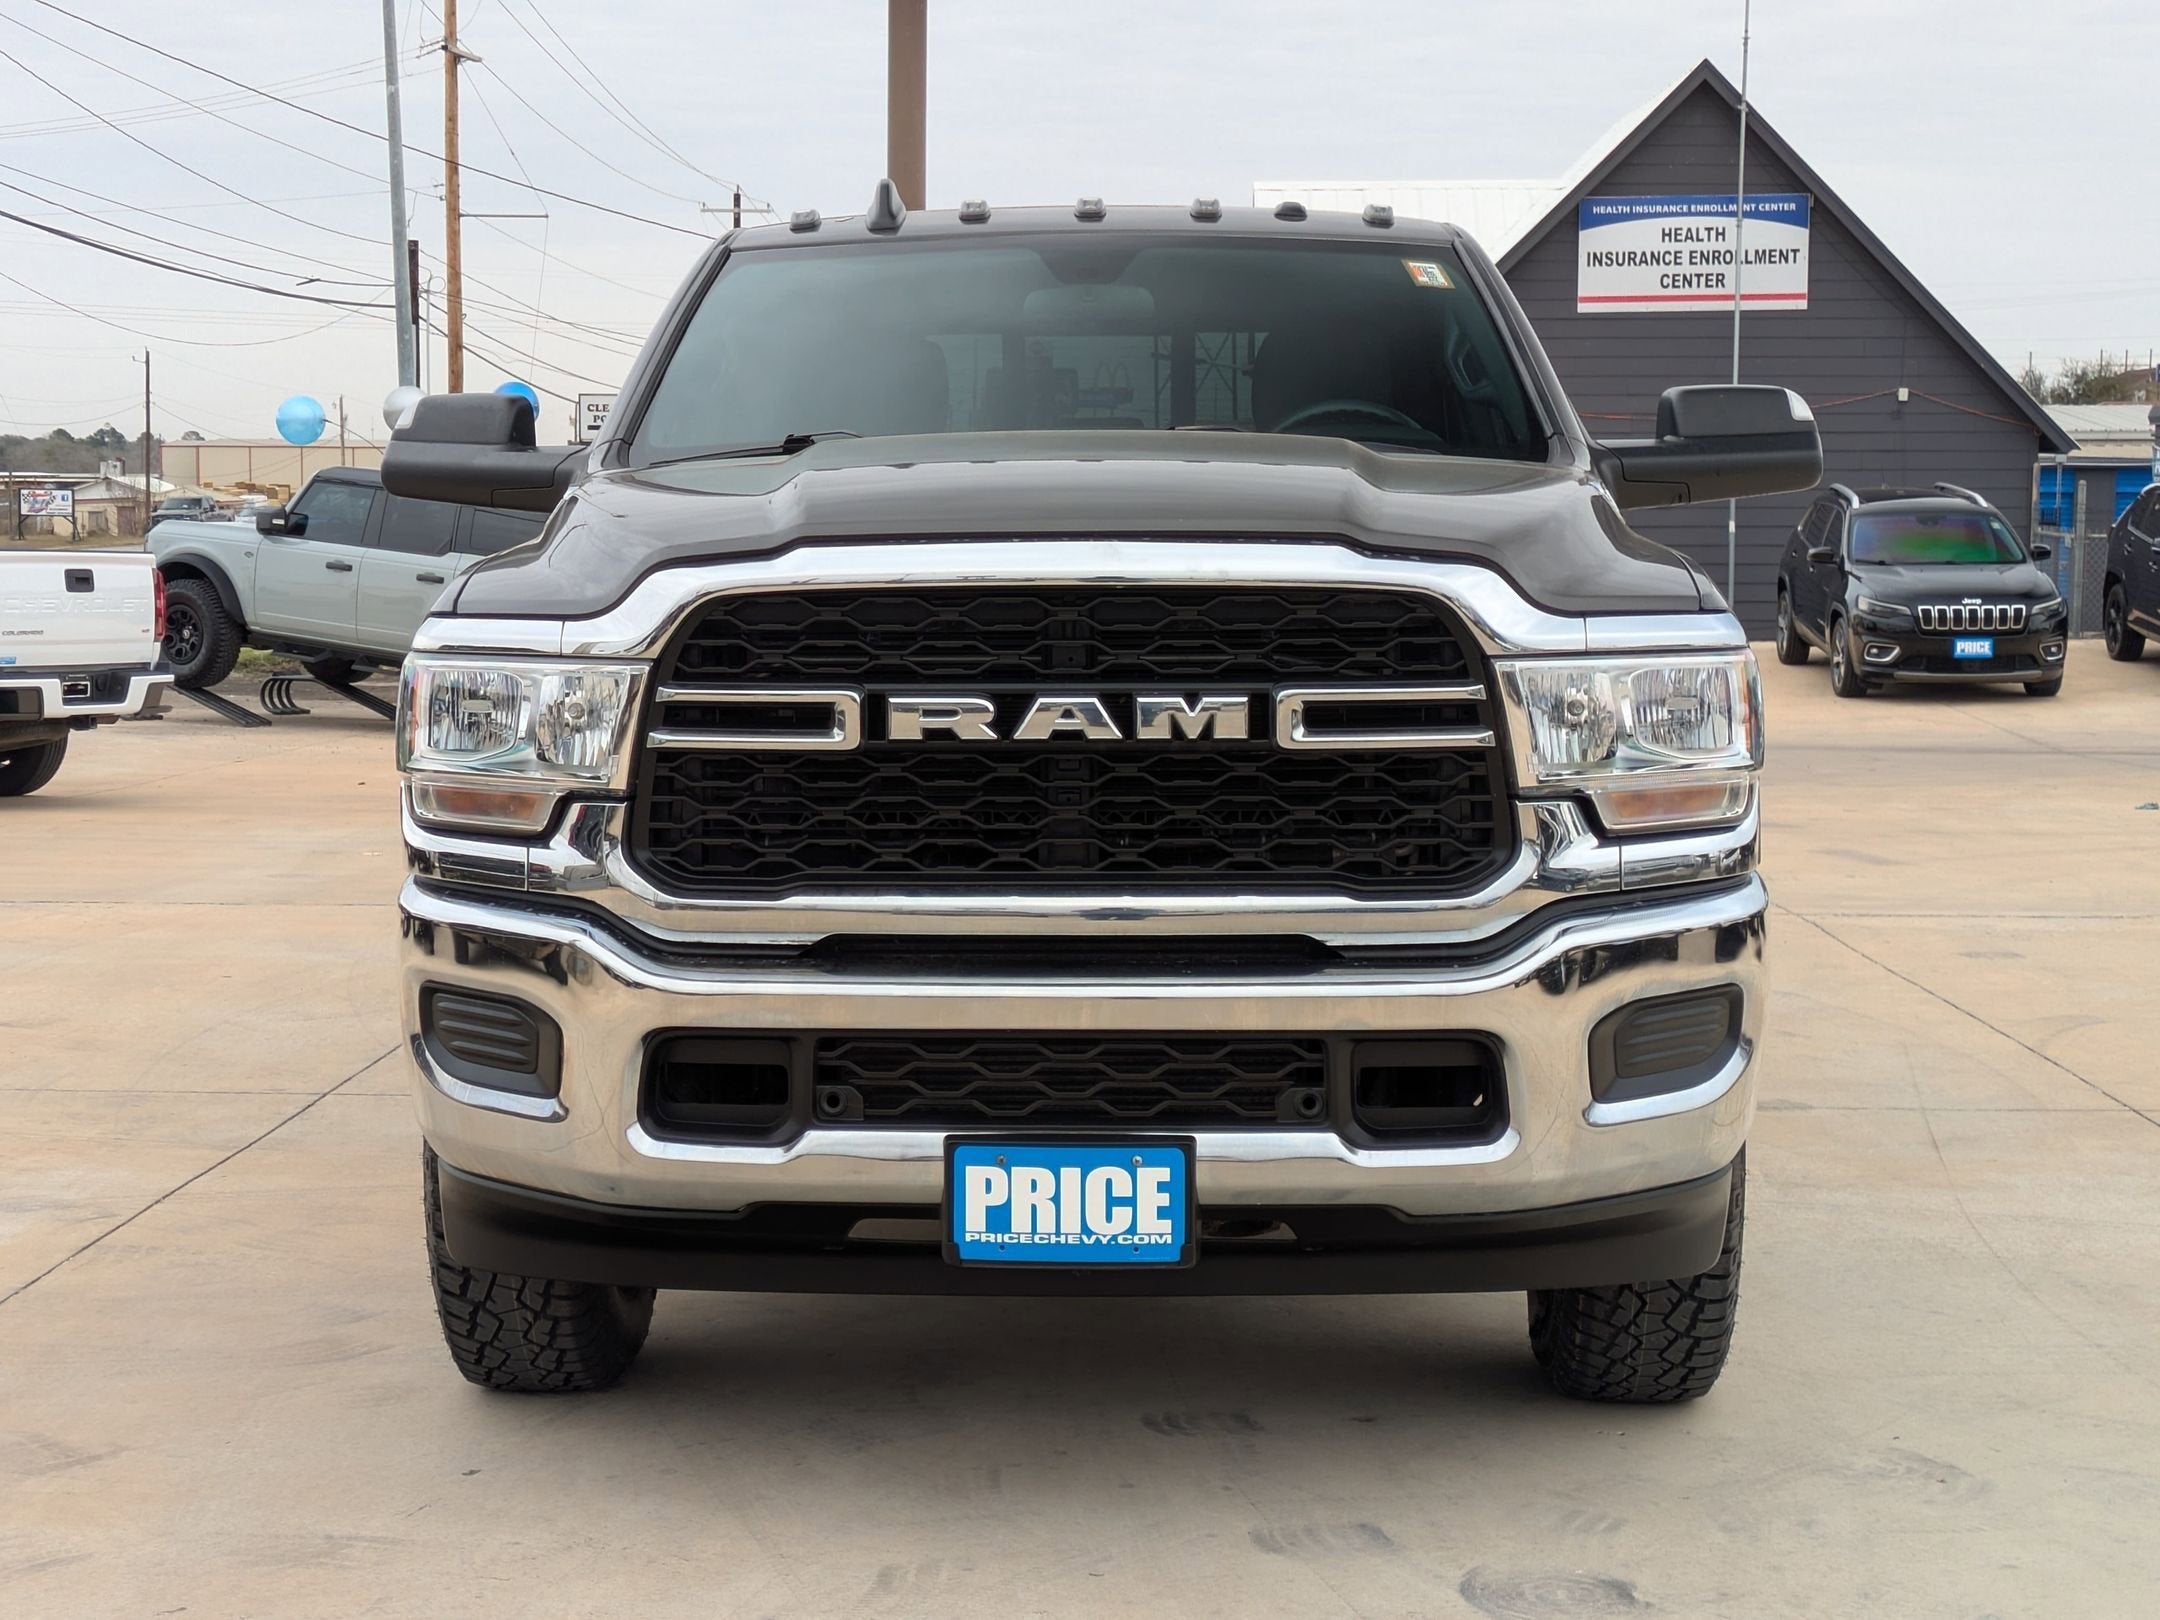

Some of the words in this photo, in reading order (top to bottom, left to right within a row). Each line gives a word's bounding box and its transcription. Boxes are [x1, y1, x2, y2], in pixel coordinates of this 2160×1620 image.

[1593, 205, 1630, 214] HEALTH
[1632, 204, 1688, 213] INSURANCE
[1691, 203, 1756, 213] ENROLLMNT
[1758, 202, 1796, 212] CENTER
[1661, 227, 1726, 243] HEALTH
[1587, 250, 1682, 267] INSURANCE
[1660, 273, 1725, 289] CENTER
[1956, 641, 1991, 654] PRICE
[888, 696, 1248, 739] RAM
[965, 1166, 1172, 1235] PRICE
[965, 1233, 1172, 1244] PRICECHEVY.COM
